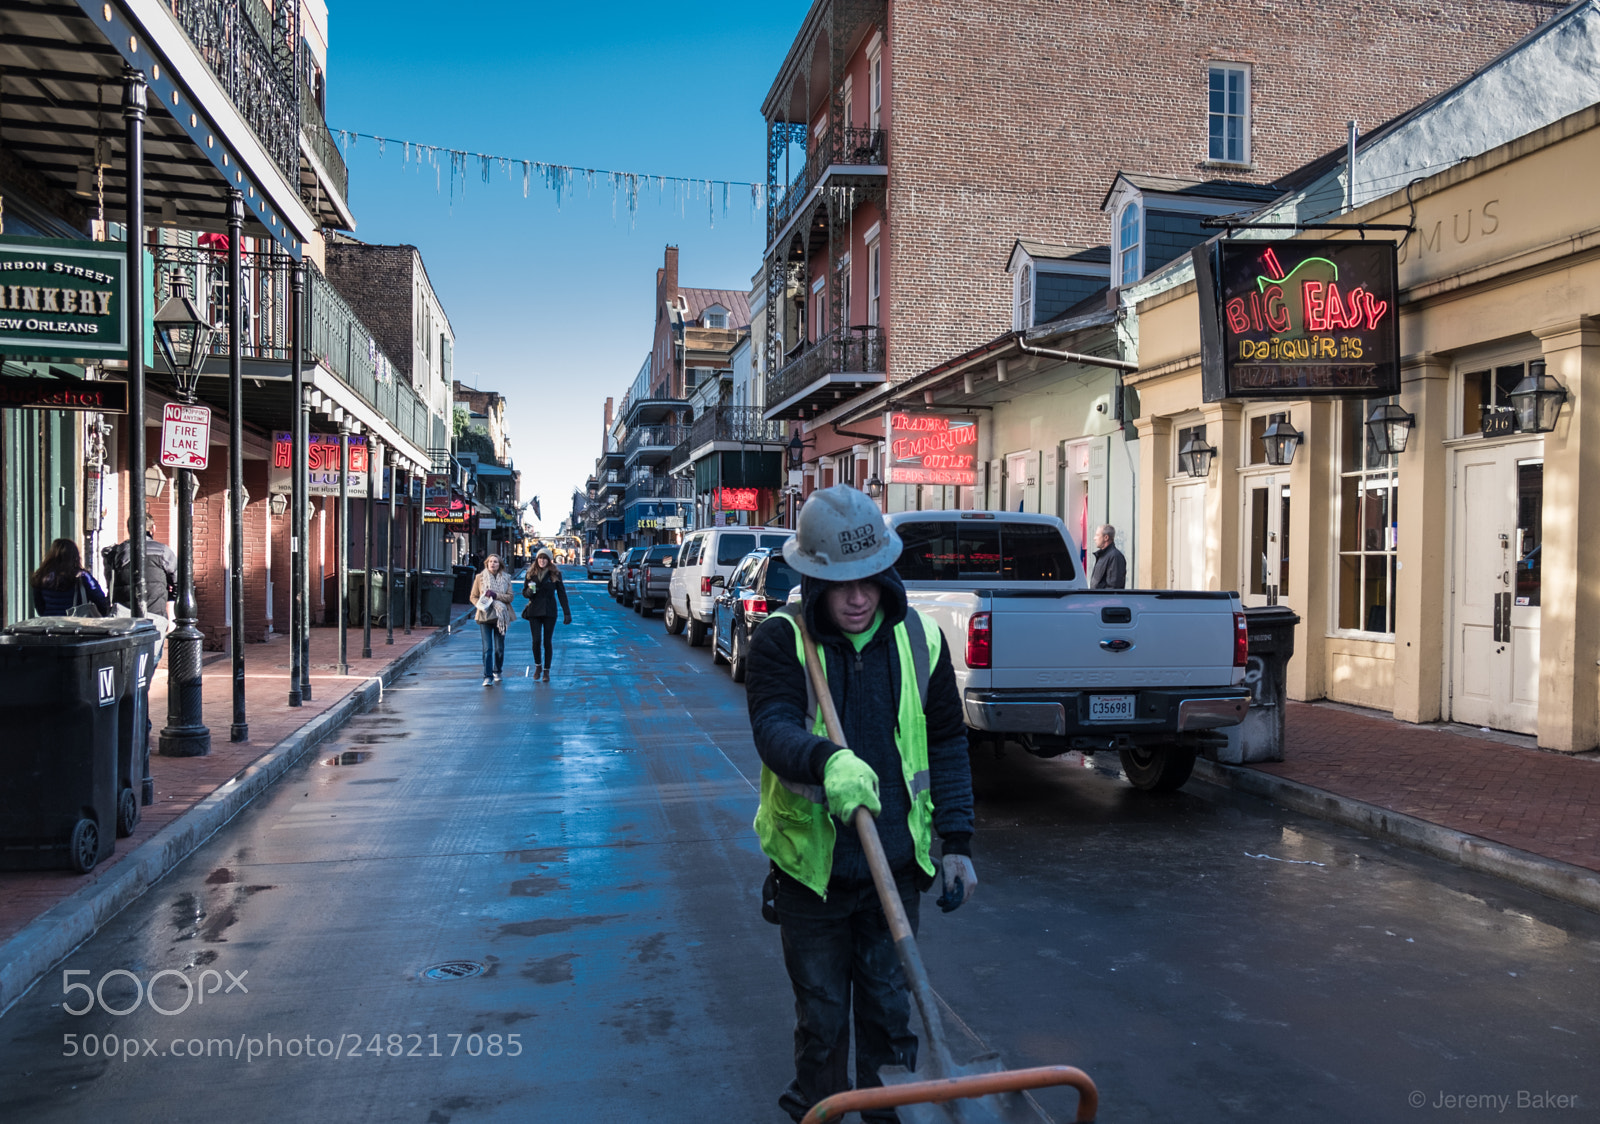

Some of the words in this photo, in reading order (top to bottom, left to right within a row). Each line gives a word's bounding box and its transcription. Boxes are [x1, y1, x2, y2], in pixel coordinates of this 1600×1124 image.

[0, 261, 47, 271] RBON
[53, 262, 114, 284] STREET
[1226, 284, 1292, 334] BIG
[1304, 281, 1387, 331] EASY
[26, 319, 99, 334] ORLEANS
[166, 406, 181, 420] NO
[175, 425, 198, 437] FIRE
[1485, 414, 1509, 433] 216
[172, 438, 199, 450] LANE
[892, 425, 977, 460] EMPORIUM
[923, 454, 974, 468] OUTLET
[838, 523, 874, 543] HARD
[841, 533, 876, 555] ROCK
[1036, 671, 1118, 684] SUPER
[1132, 670, 1194, 683] DUTY
[1092, 702, 1132, 714] C356981
